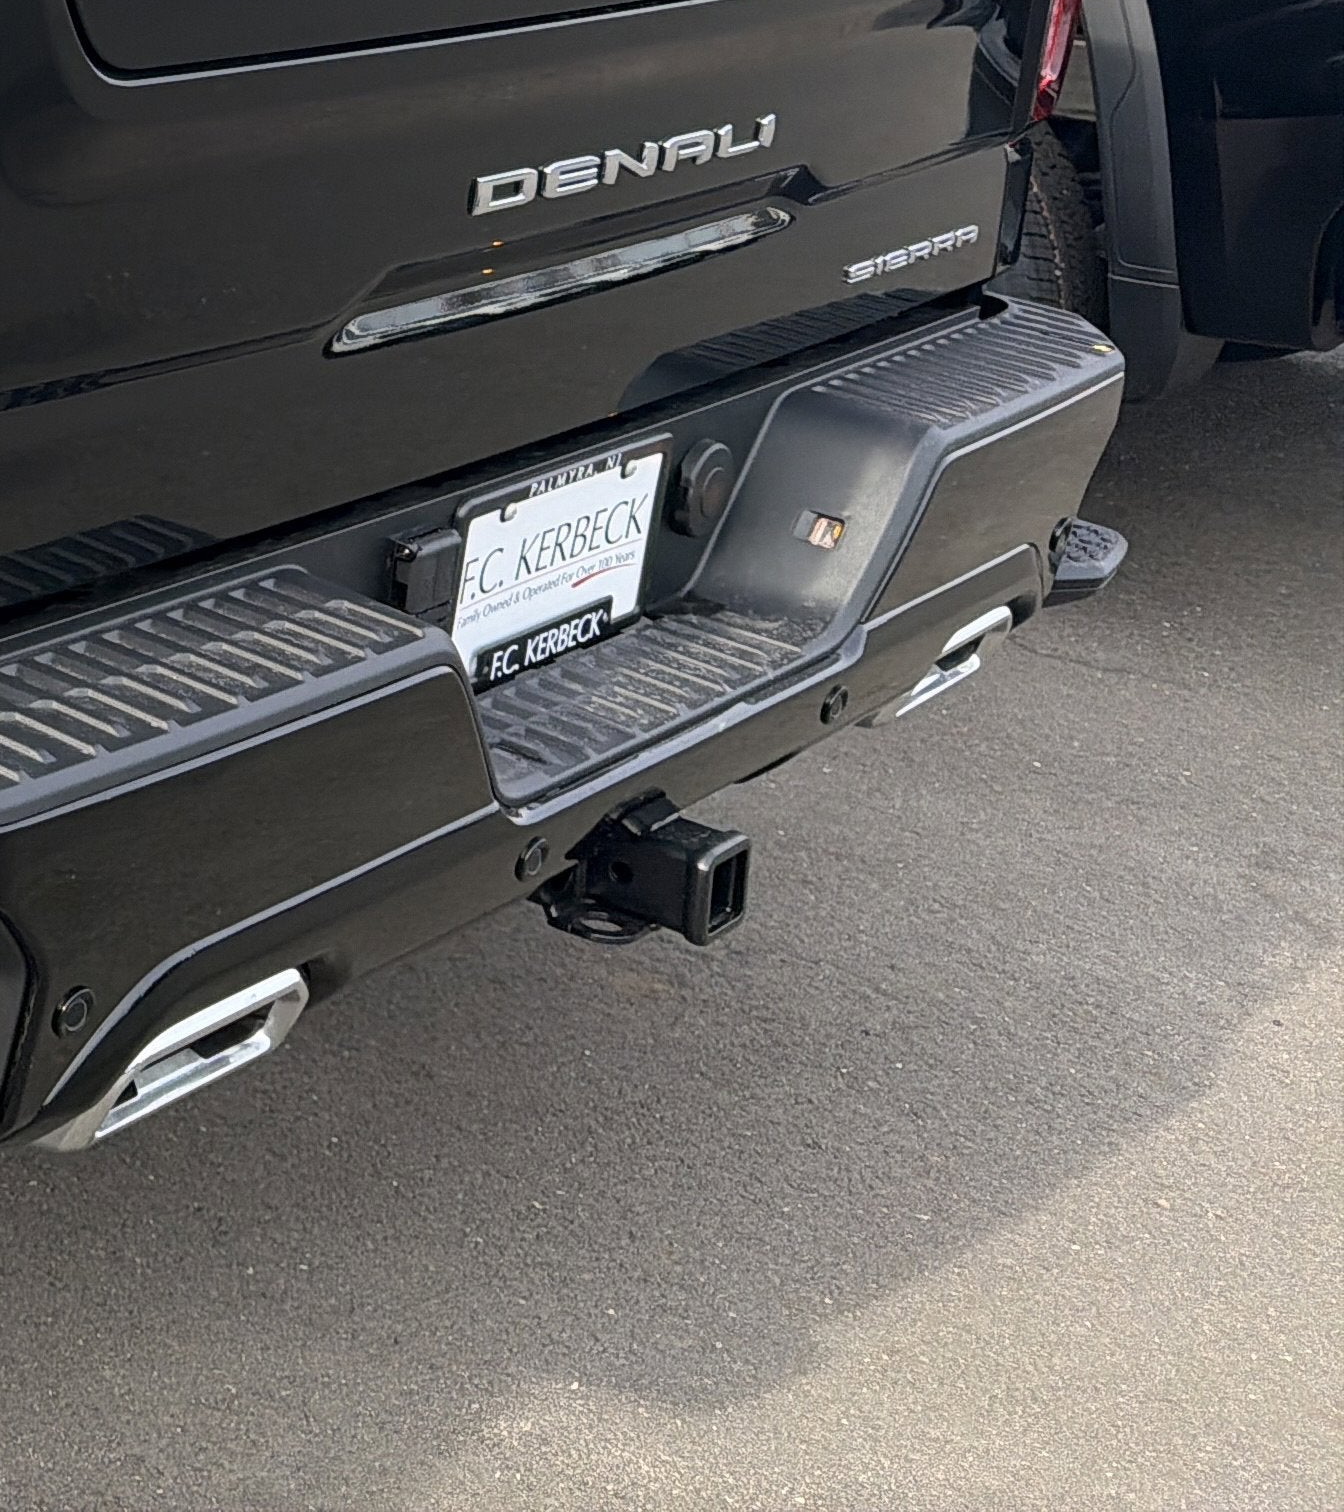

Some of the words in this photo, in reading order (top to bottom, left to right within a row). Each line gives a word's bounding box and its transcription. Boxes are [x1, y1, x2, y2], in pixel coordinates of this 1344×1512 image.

[469, 114, 776, 217] DENALI
[842, 224, 979, 284] SIERRA
[459, 547, 504, 605] F.C.
[514, 492, 649, 582] KERBECK
[457, 607, 482, 629] Family
[482, 596, 513, 617] Owned
[513, 592, 520, 604] &
[522, 575, 561, 601] Operated
[560, 571, 574, 586] For
[575, 562, 596, 578] Over
[598, 555, 613, 569] 100
[614, 549, 636, 565] Years
[490, 644, 520, 681] F.C.
[524, 608, 605, 666] KERBECK
